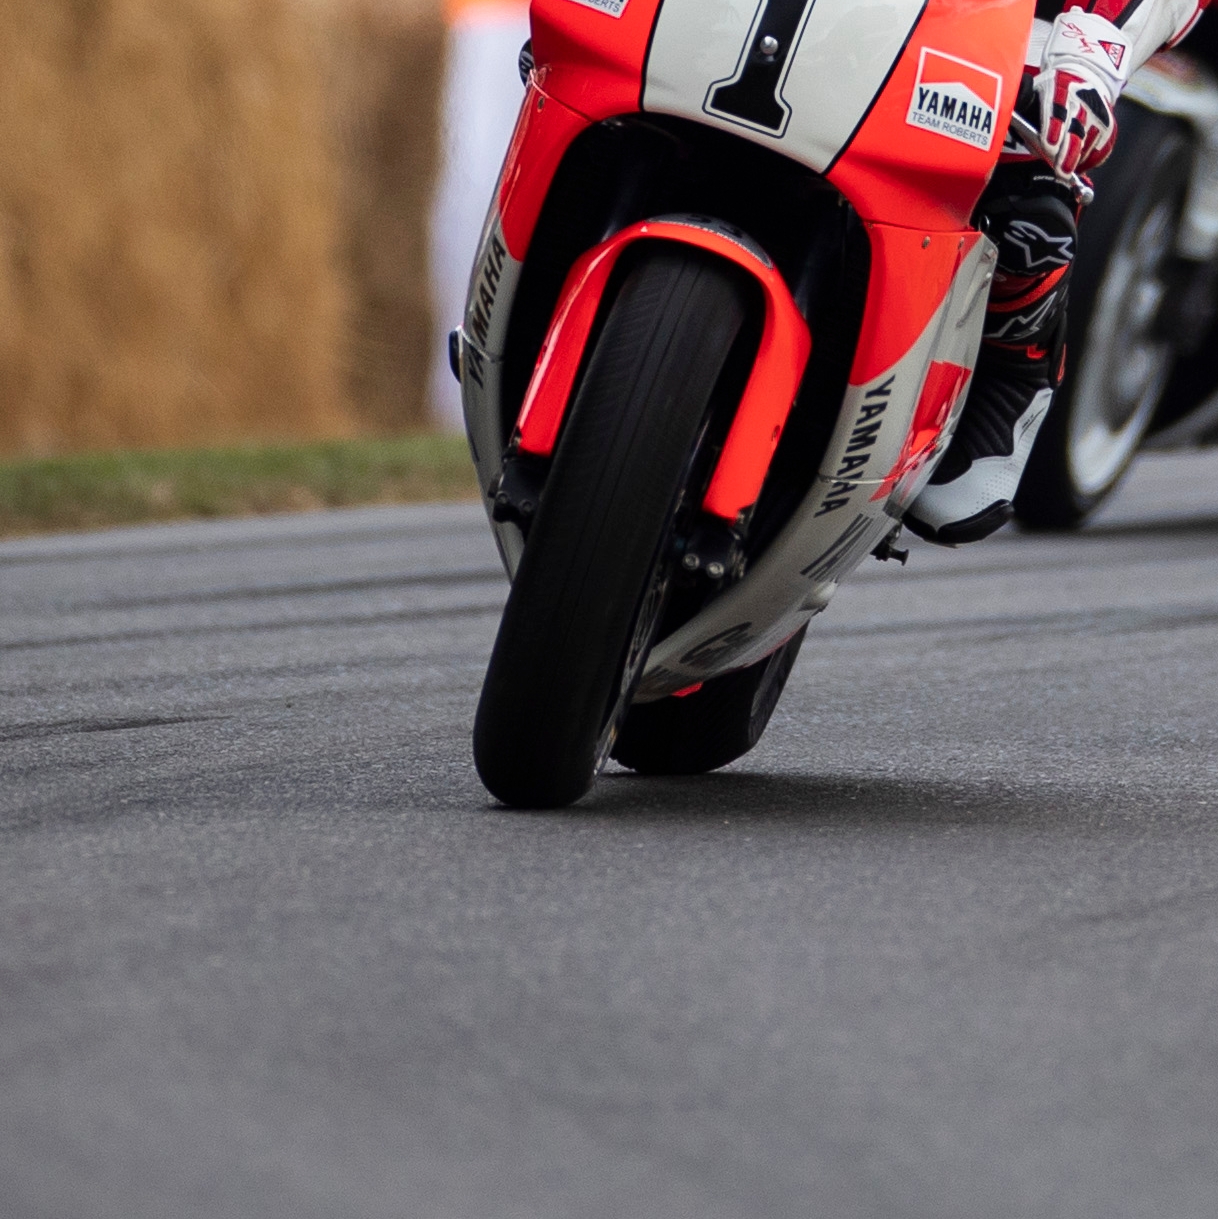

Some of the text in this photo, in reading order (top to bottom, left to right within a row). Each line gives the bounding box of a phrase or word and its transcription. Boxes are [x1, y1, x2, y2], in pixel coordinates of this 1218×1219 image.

[911, 111, 988, 146] TEAM ROBERTS
[917, 87, 993, 134] YAMAHA
[468, 236, 506, 390] YAMAHA
[813, 374, 897, 519] YAMAHA
